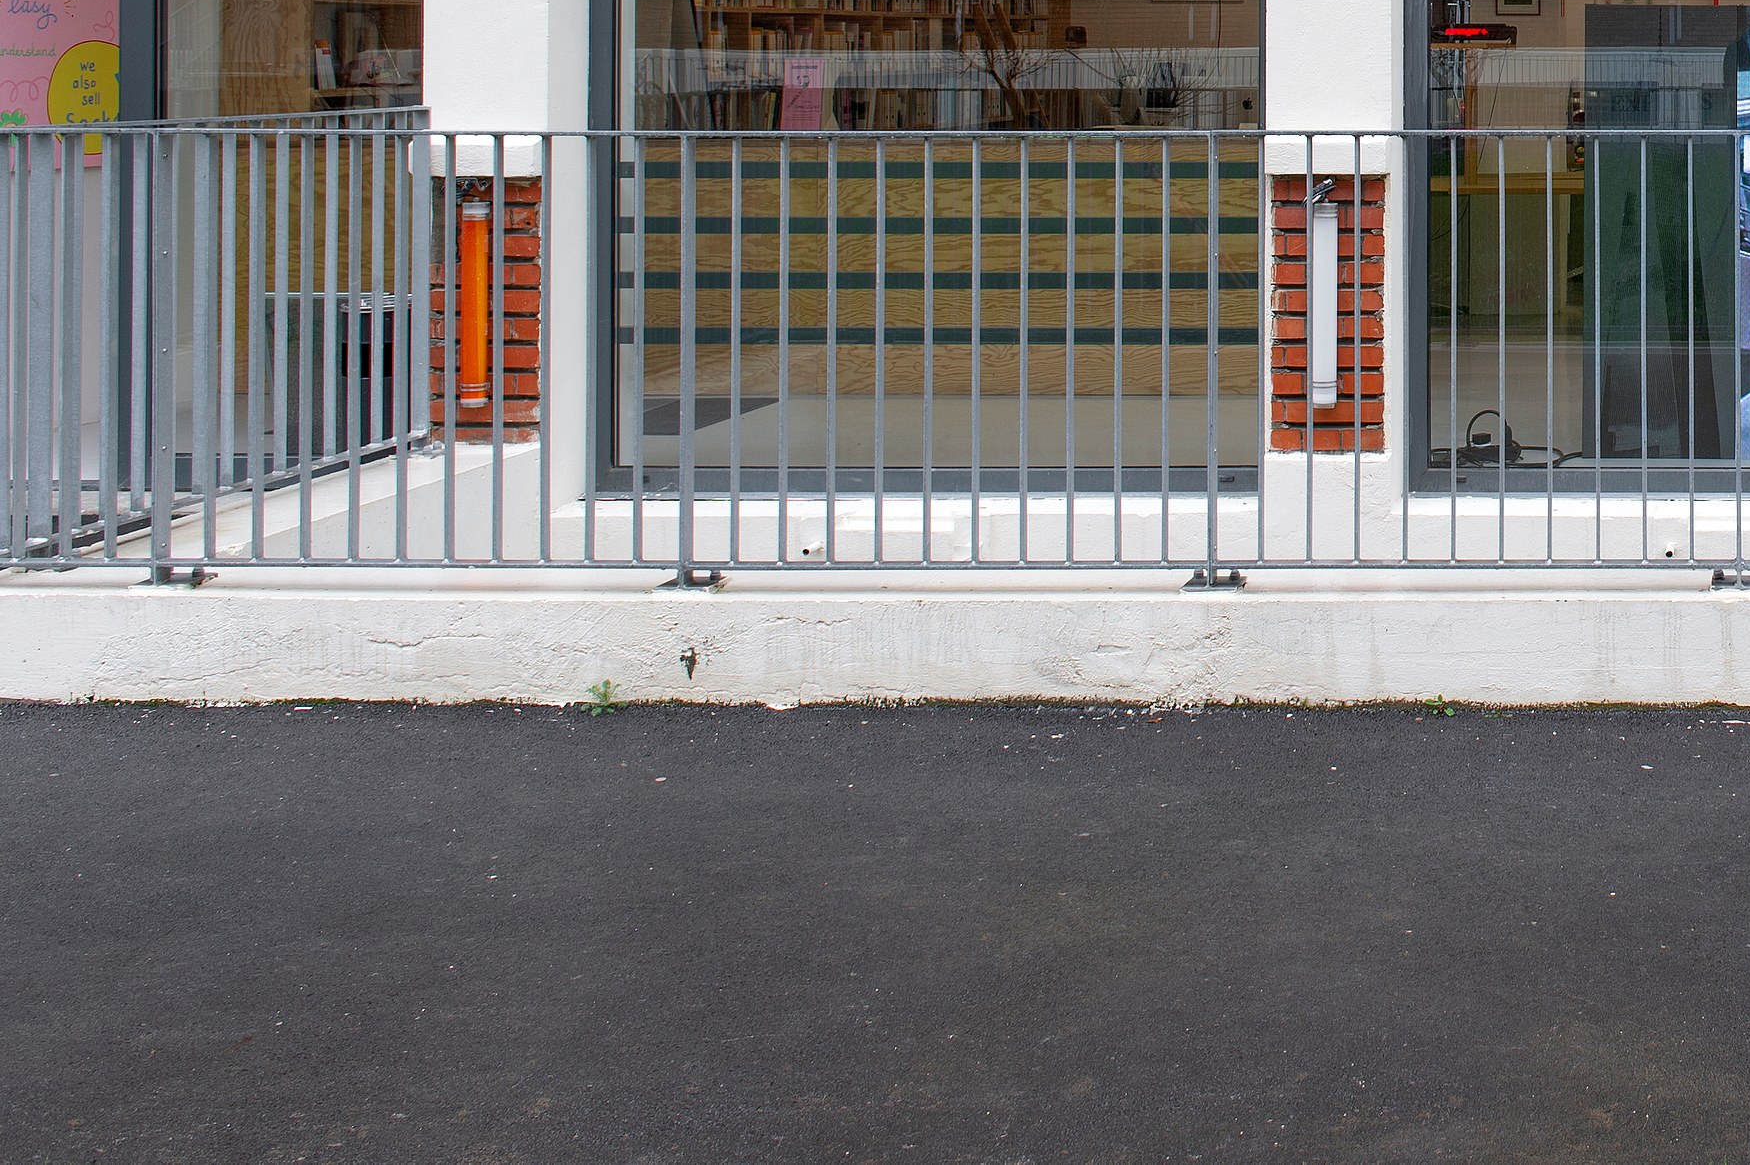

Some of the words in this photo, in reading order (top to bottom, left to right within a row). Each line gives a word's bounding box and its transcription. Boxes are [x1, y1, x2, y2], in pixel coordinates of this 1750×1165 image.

[80, 61, 95, 72] we
[72, 75, 97, 89] also
[81, 92, 101, 105] sell
